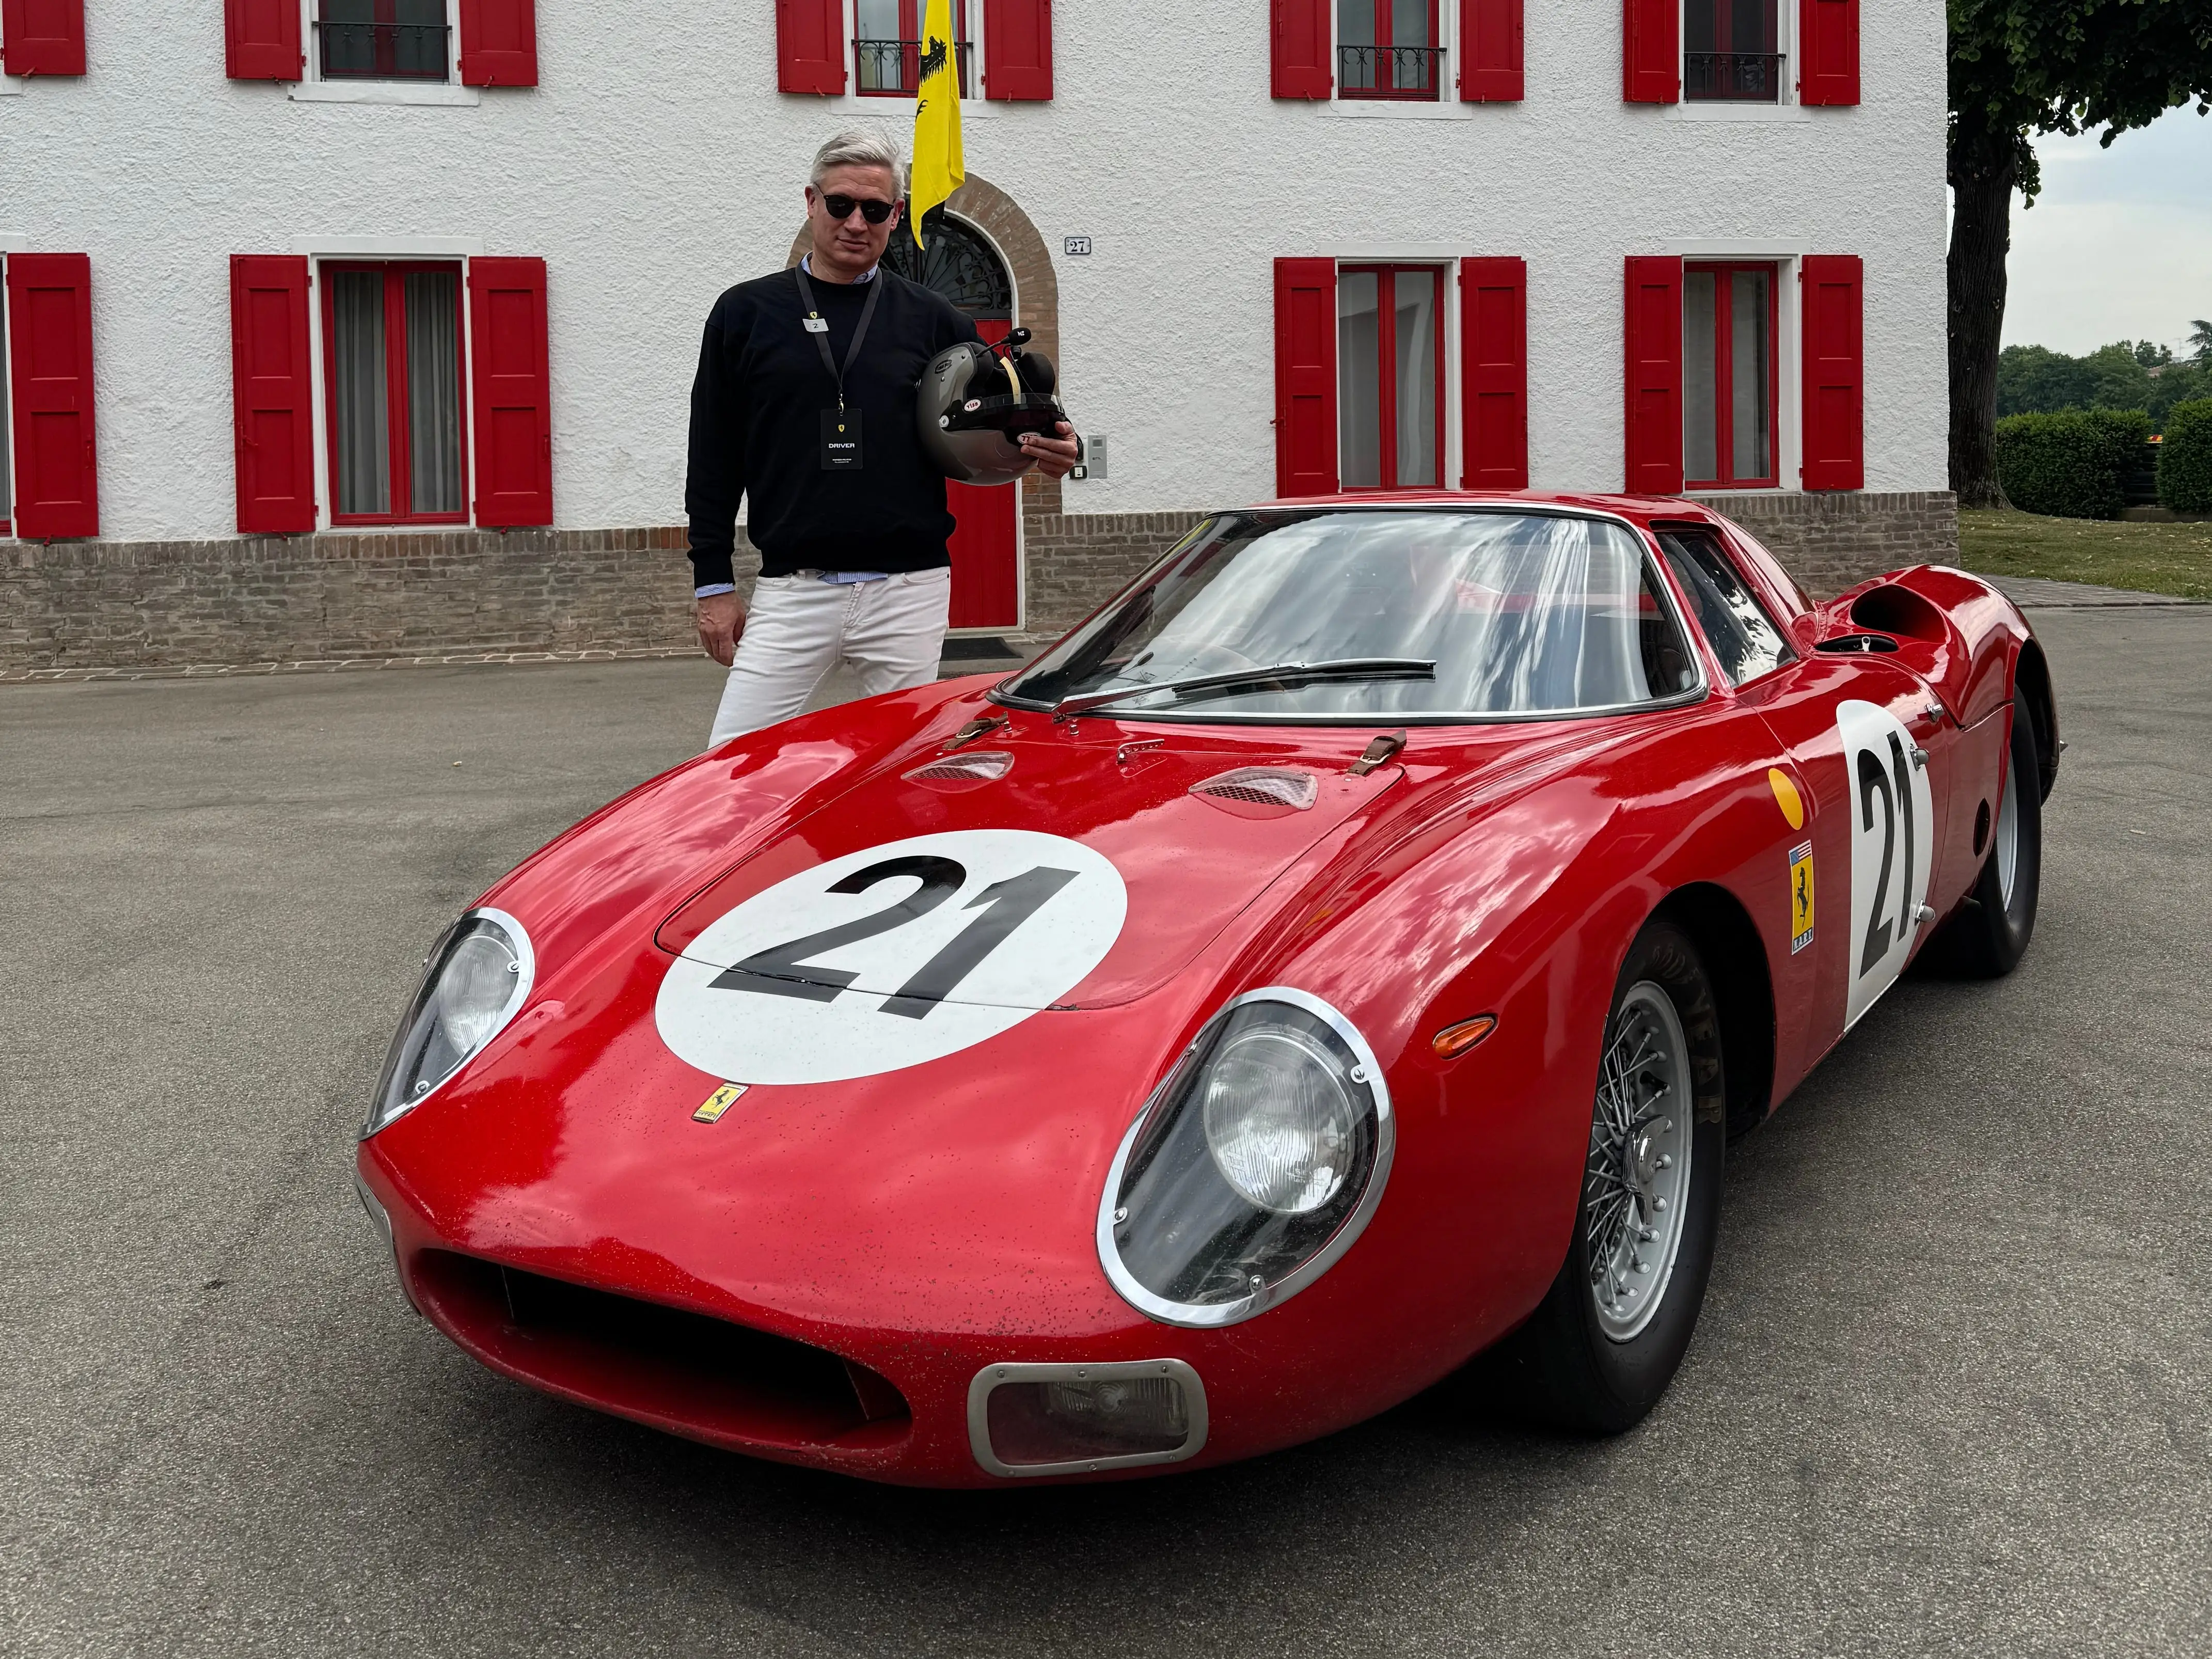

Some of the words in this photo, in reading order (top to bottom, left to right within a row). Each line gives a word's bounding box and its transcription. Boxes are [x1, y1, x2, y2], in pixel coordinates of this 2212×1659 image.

[1070, 241, 1085, 252] 27
[707, 855, 1081, 1020] 21
[1857, 730, 1914, 980] 21
